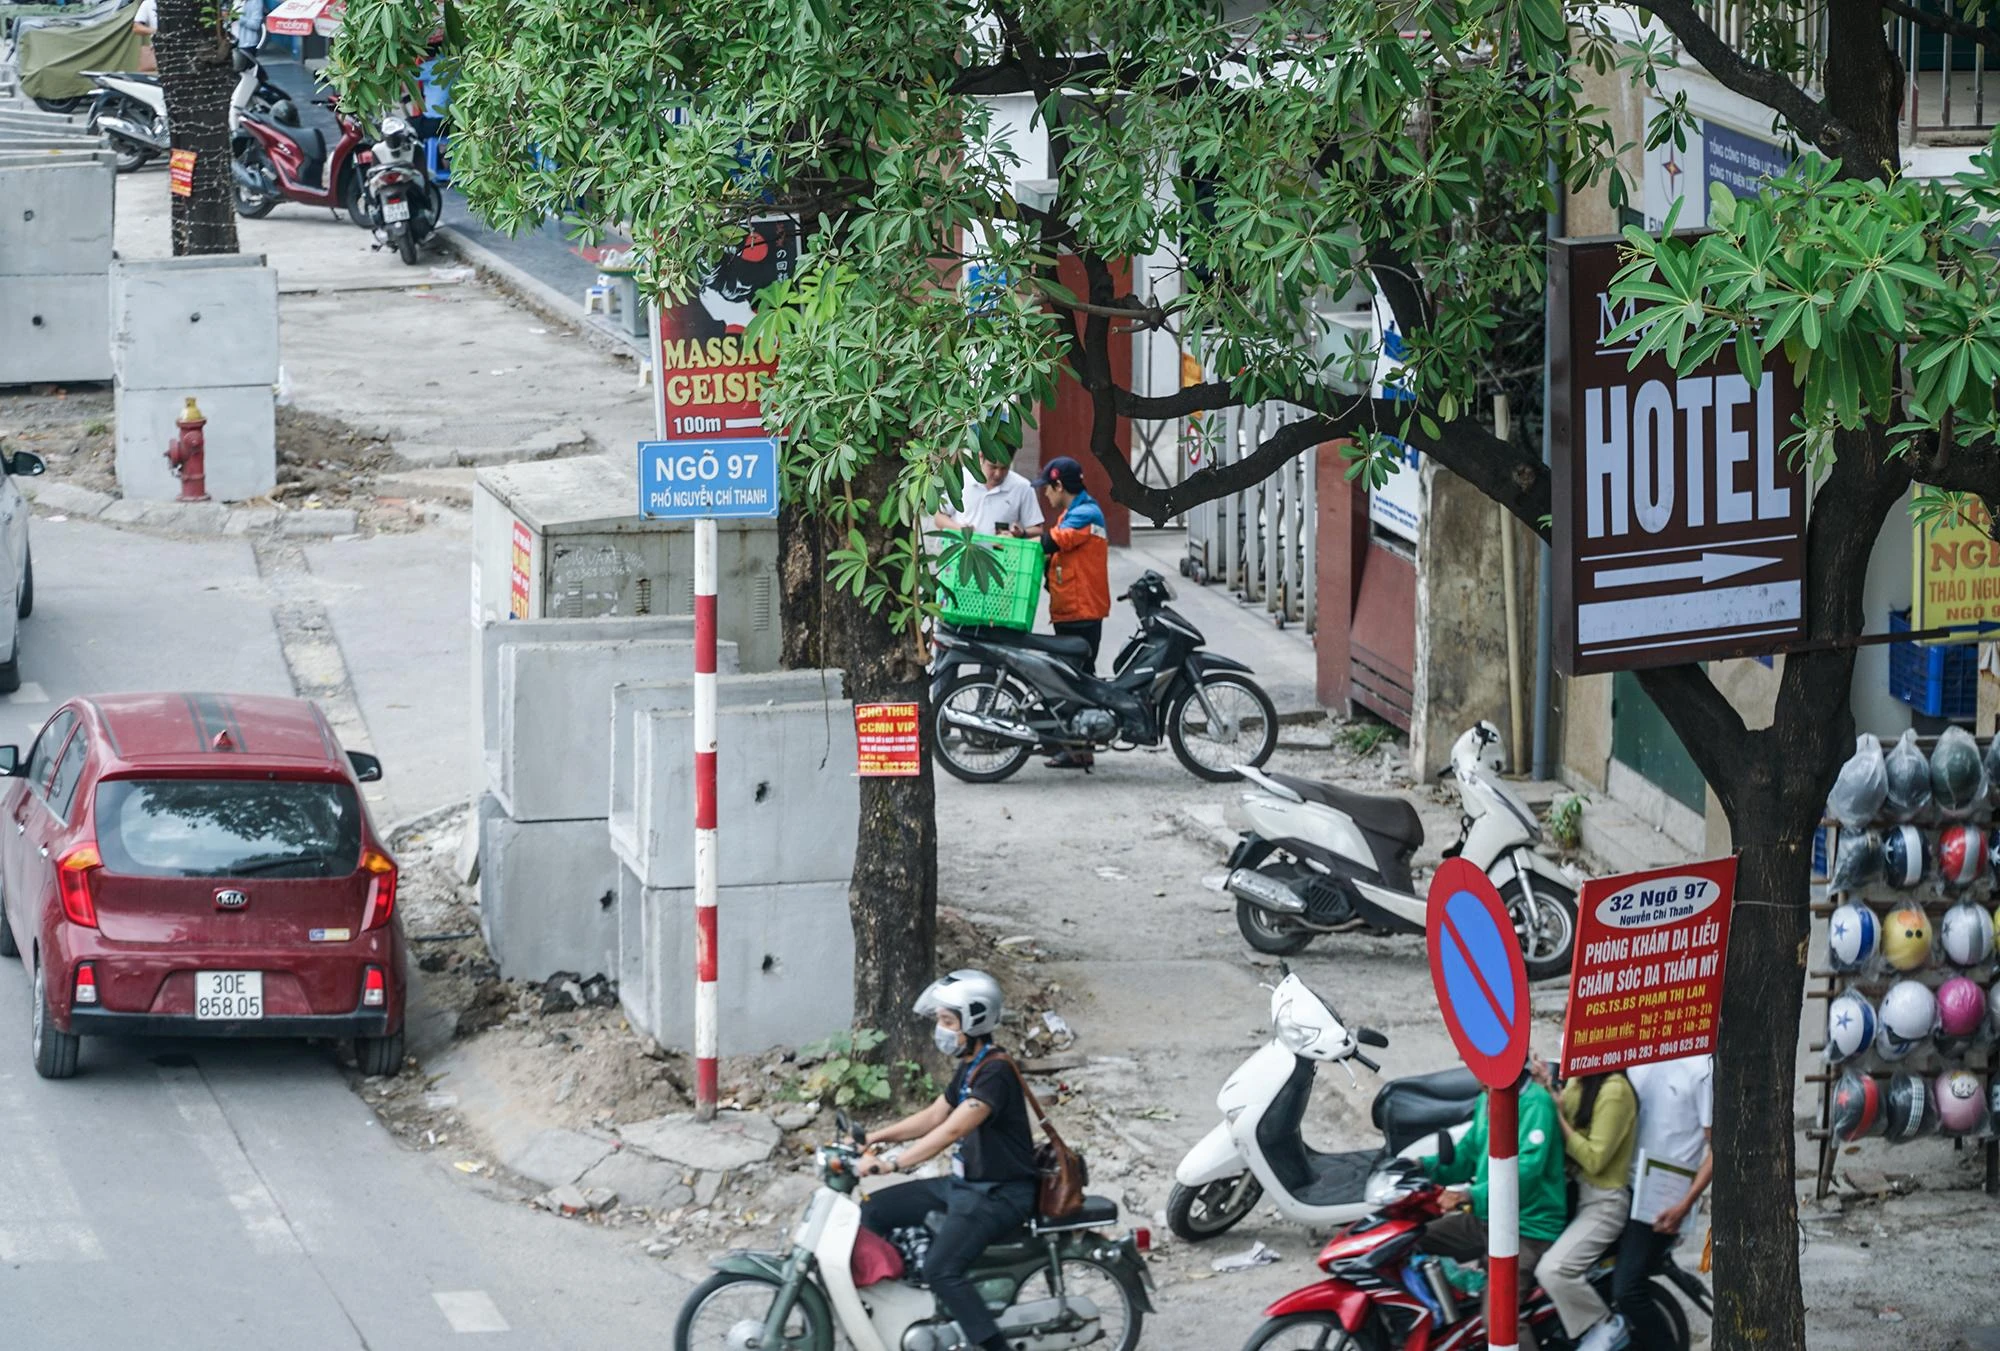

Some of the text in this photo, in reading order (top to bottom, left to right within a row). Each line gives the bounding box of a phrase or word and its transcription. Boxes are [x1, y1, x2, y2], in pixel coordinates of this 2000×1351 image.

[1740, 152, 1748, 165] TY
[1725, 169, 1732, 182] TY
[673, 416, 722, 434] 100m
[655, 448, 759, 482] NGÕ 97
[1585, 371, 1791, 539] HOTEL
[651, 484, 768, 507] PHỐ NGUYỄN CHÍ THANH
[859, 721, 916, 733] CCMN VIP
[219, 891, 244, 905] KIA
[1609, 881, 1708, 912] 32 Ngõ 97
[1619, 904, 1694, 926] Nguyễn Chí Thanh
[1584, 916, 1720, 966] PHÒNG KHÁM DA LIỄU
[212, 974, 246, 994] 30E
[1577, 949, 1720, 999] CHĂM SÓC DA THẨM MỸ
[199, 997, 260, 1017] 858.05
[1585, 984, 1706, 1017] PGS.TS.BS PHẠM THỊ LAN
[1653, 1011, 1659, 1024] 2
[1652, 1026, 1657, 1039] 7
[1662, 1024, 1672, 1037] CN
